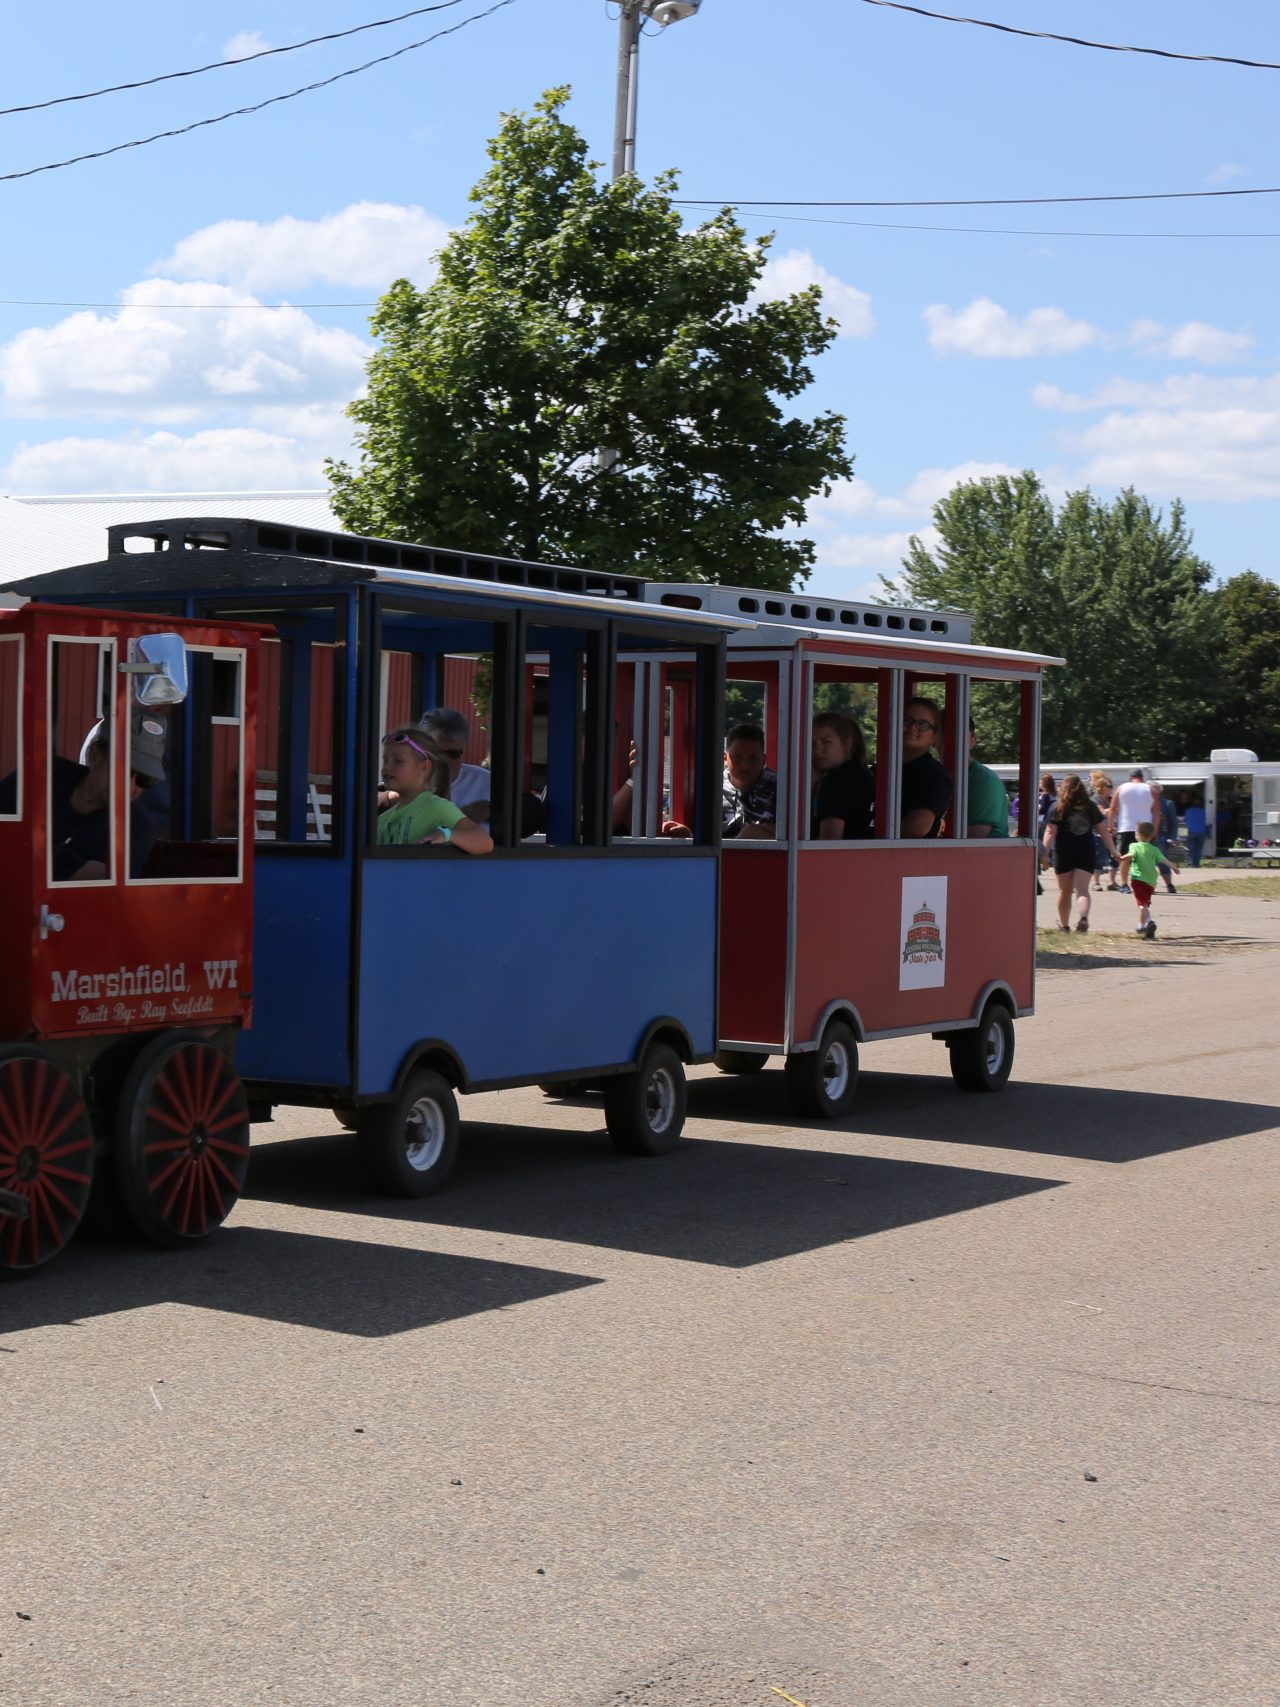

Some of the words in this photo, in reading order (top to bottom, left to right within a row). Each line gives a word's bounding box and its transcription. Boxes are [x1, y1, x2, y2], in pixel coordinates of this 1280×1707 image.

[51, 963, 191, 1002] Marshfield,
[203, 959, 239, 990] WI
[76, 1005, 109, 1025] Built
[140, 1000, 168, 1022] Ray
